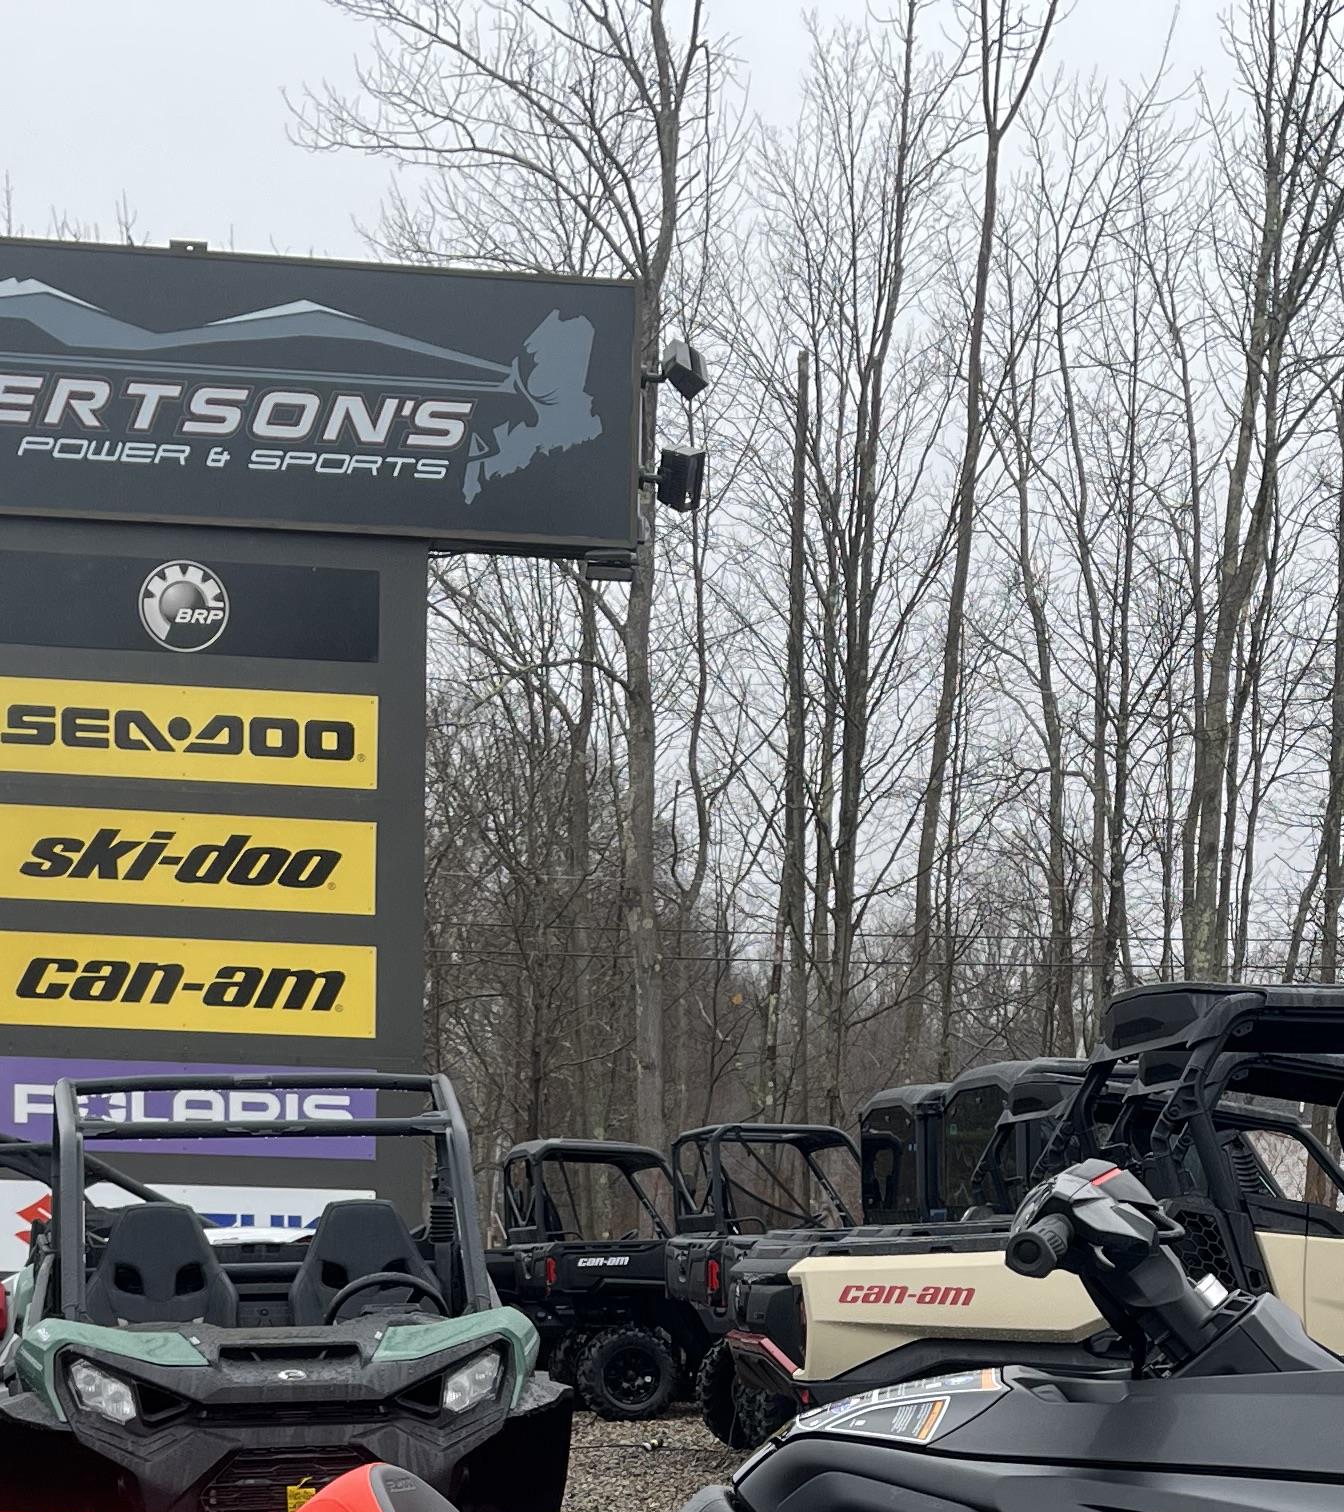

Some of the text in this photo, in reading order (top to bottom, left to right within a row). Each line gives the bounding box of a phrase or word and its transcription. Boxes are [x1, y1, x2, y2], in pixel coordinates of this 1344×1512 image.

[17, 436, 450, 478] POWER & SPORTS
[174, 607, 224, 625] BRP
[19, 828, 343, 889] ski-doo
[16, 956, 347, 1013] can-am
[838, 1284, 976, 1306] can-am
